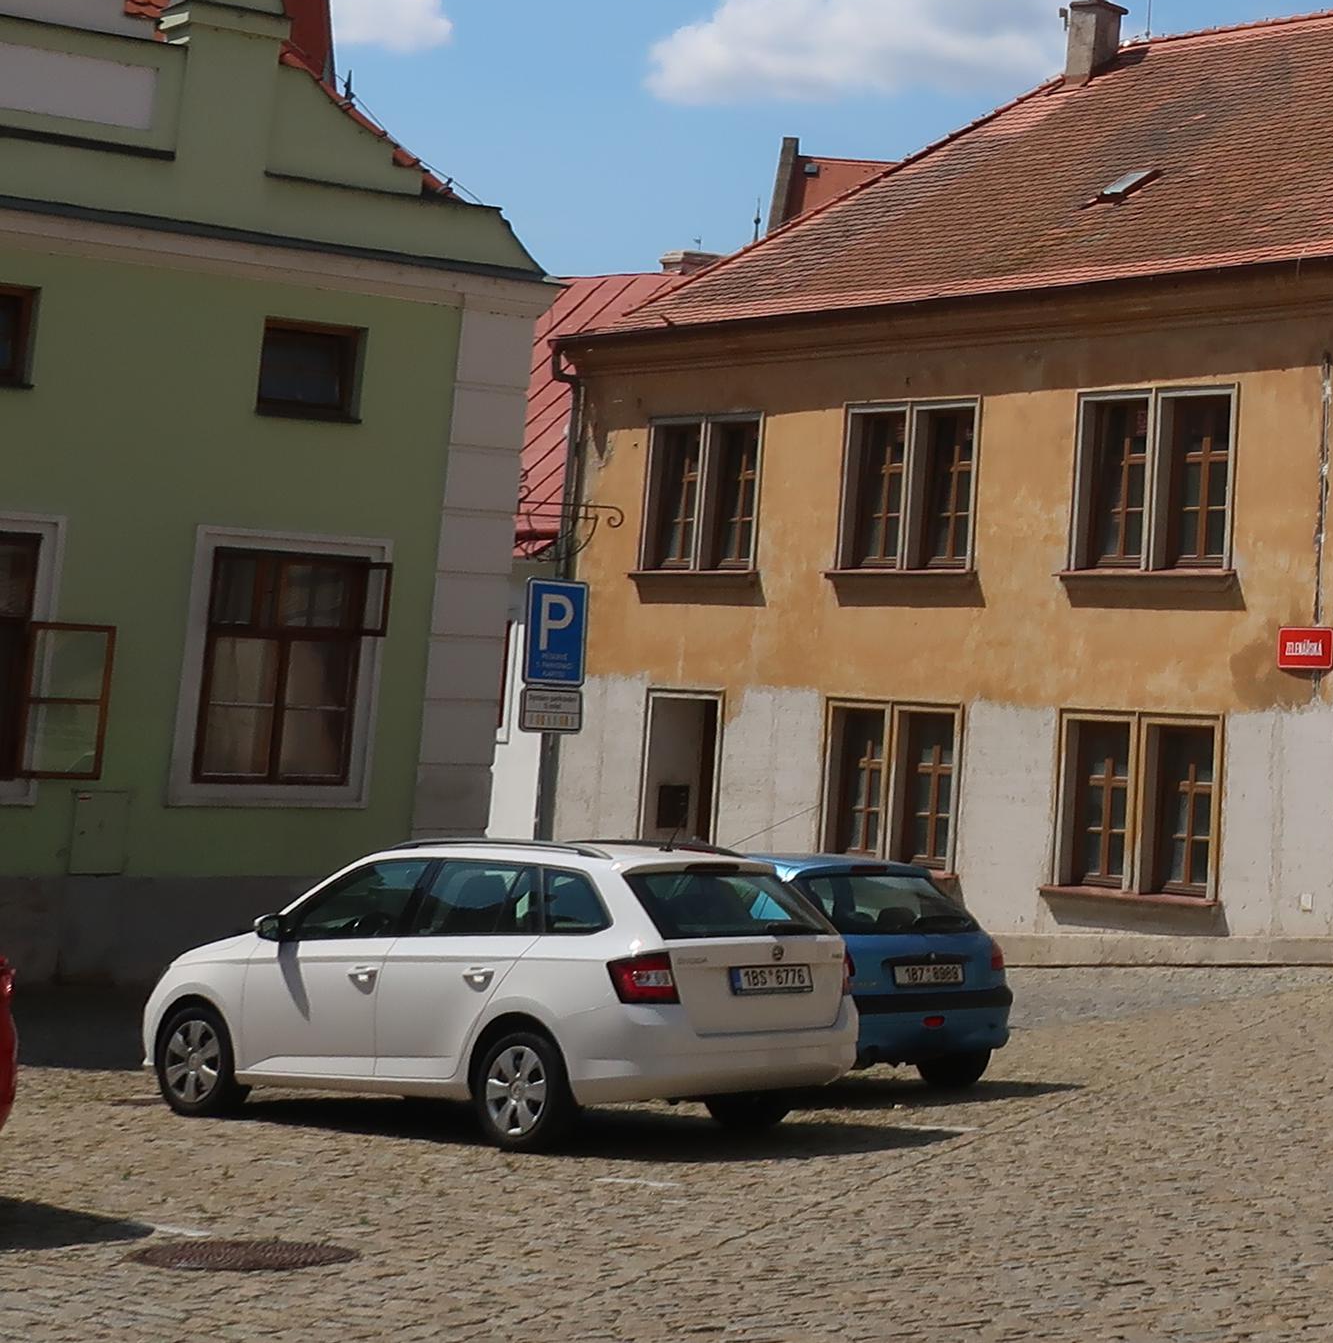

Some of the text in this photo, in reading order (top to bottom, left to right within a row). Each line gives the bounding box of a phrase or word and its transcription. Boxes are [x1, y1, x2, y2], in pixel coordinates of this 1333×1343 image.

[539, 593, 574, 651] P
[744, 966, 806, 986] 1BS 6776
